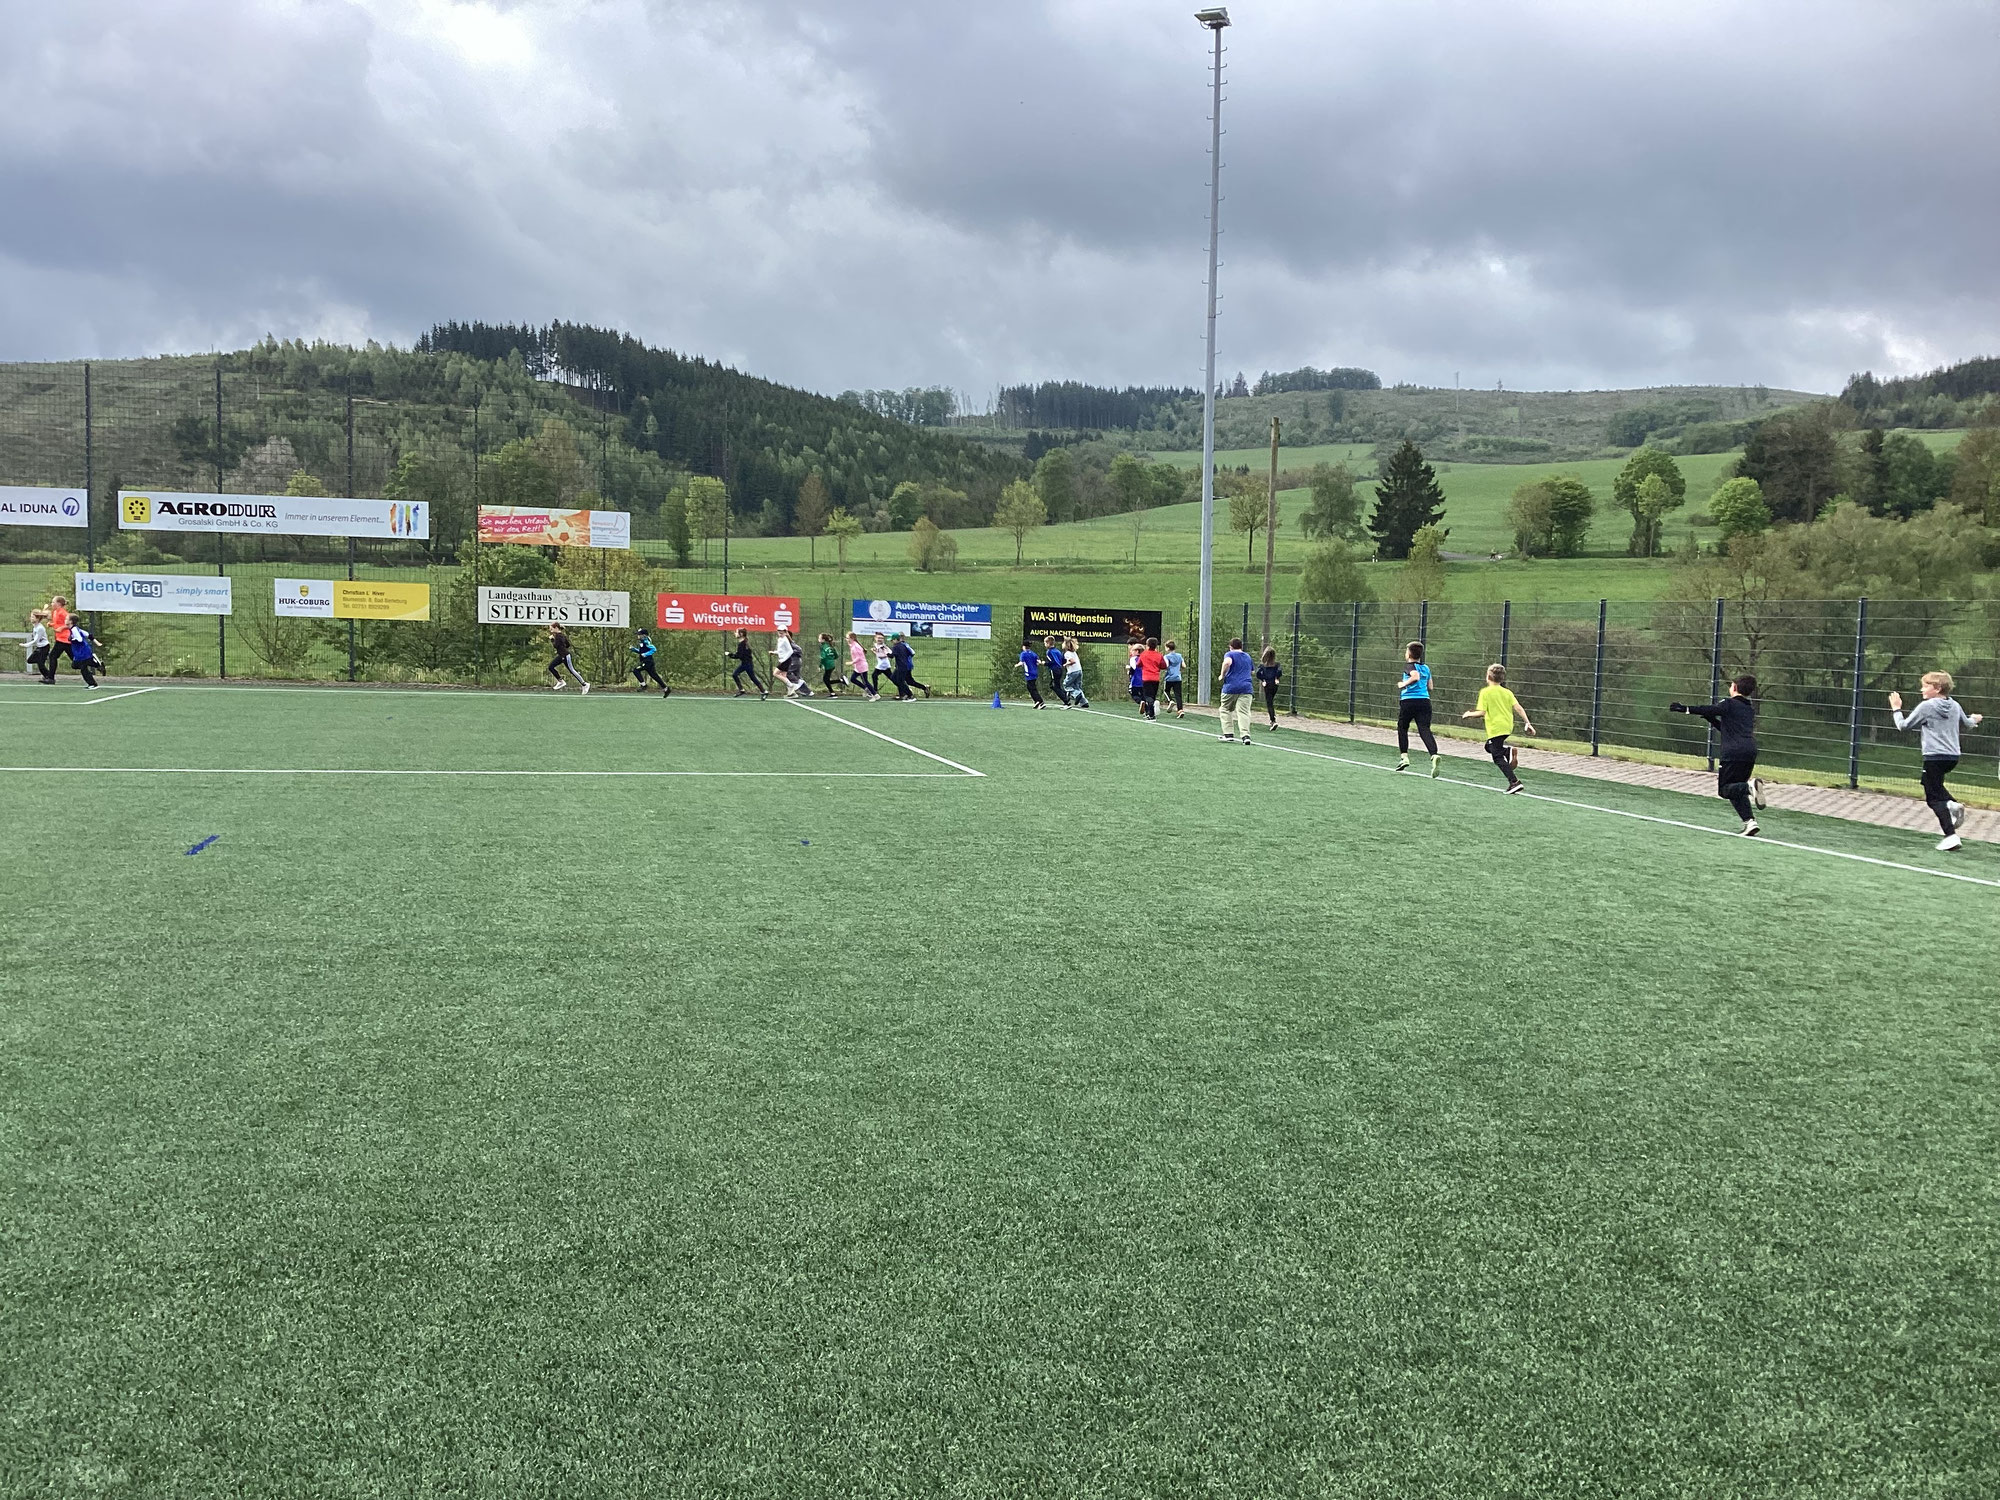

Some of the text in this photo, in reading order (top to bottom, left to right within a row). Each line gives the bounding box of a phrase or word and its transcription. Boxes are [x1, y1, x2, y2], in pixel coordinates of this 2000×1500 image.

[20, 504, 57, 514] IDUNA
[158, 501, 277, 518] AGRODUR
[178, 518, 214, 526] Grosalski
[216, 519, 240, 527] GmbH
[250, 520, 264, 528] Co.
[284, 512, 309, 521] Immer
[310, 513, 316, 521] in
[318, 514, 349, 523] unserem
[495, 516, 523, 525] machen
[488, 589, 552, 602] Landgasthaus
[278, 598, 330, 606] HUK-COBURG
[895, 602, 979, 613] Auto-Wasch-Center
[491, 604, 616, 623] STEFFES HOF
[710, 602, 749, 614] Gut für
[692, 613, 766, 627] Wittgenstein
[895, 611, 965, 622] Reumann GmbH
[1030, 611, 1113, 625] WA-SI Wittgenstein
[1076, 630, 1112, 638] HELLWACH
